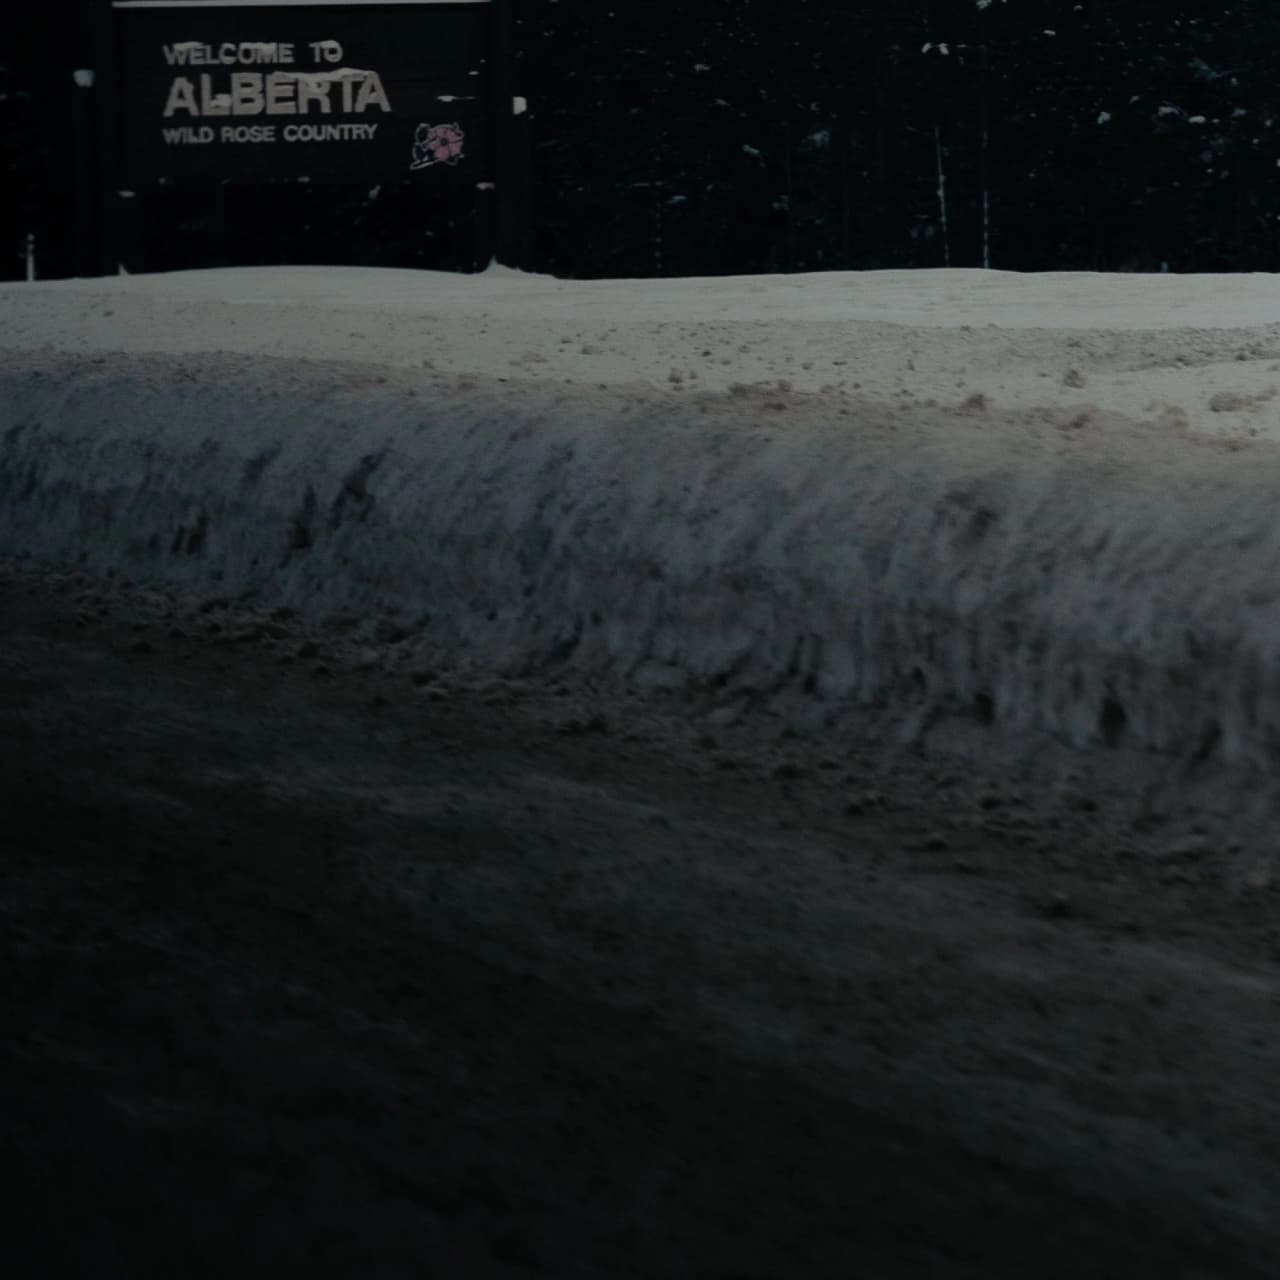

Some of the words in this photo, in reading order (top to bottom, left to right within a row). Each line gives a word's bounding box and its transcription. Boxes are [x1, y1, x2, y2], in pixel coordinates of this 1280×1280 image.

[162, 41, 295, 64] WELCOME
[309, 39, 343, 63] TO
[162, 68, 392, 118] ALBERTA
[163, 126, 215, 145] WILD
[221, 125, 276, 144] ROSE
[283, 123, 379, 142] COUNTRY
